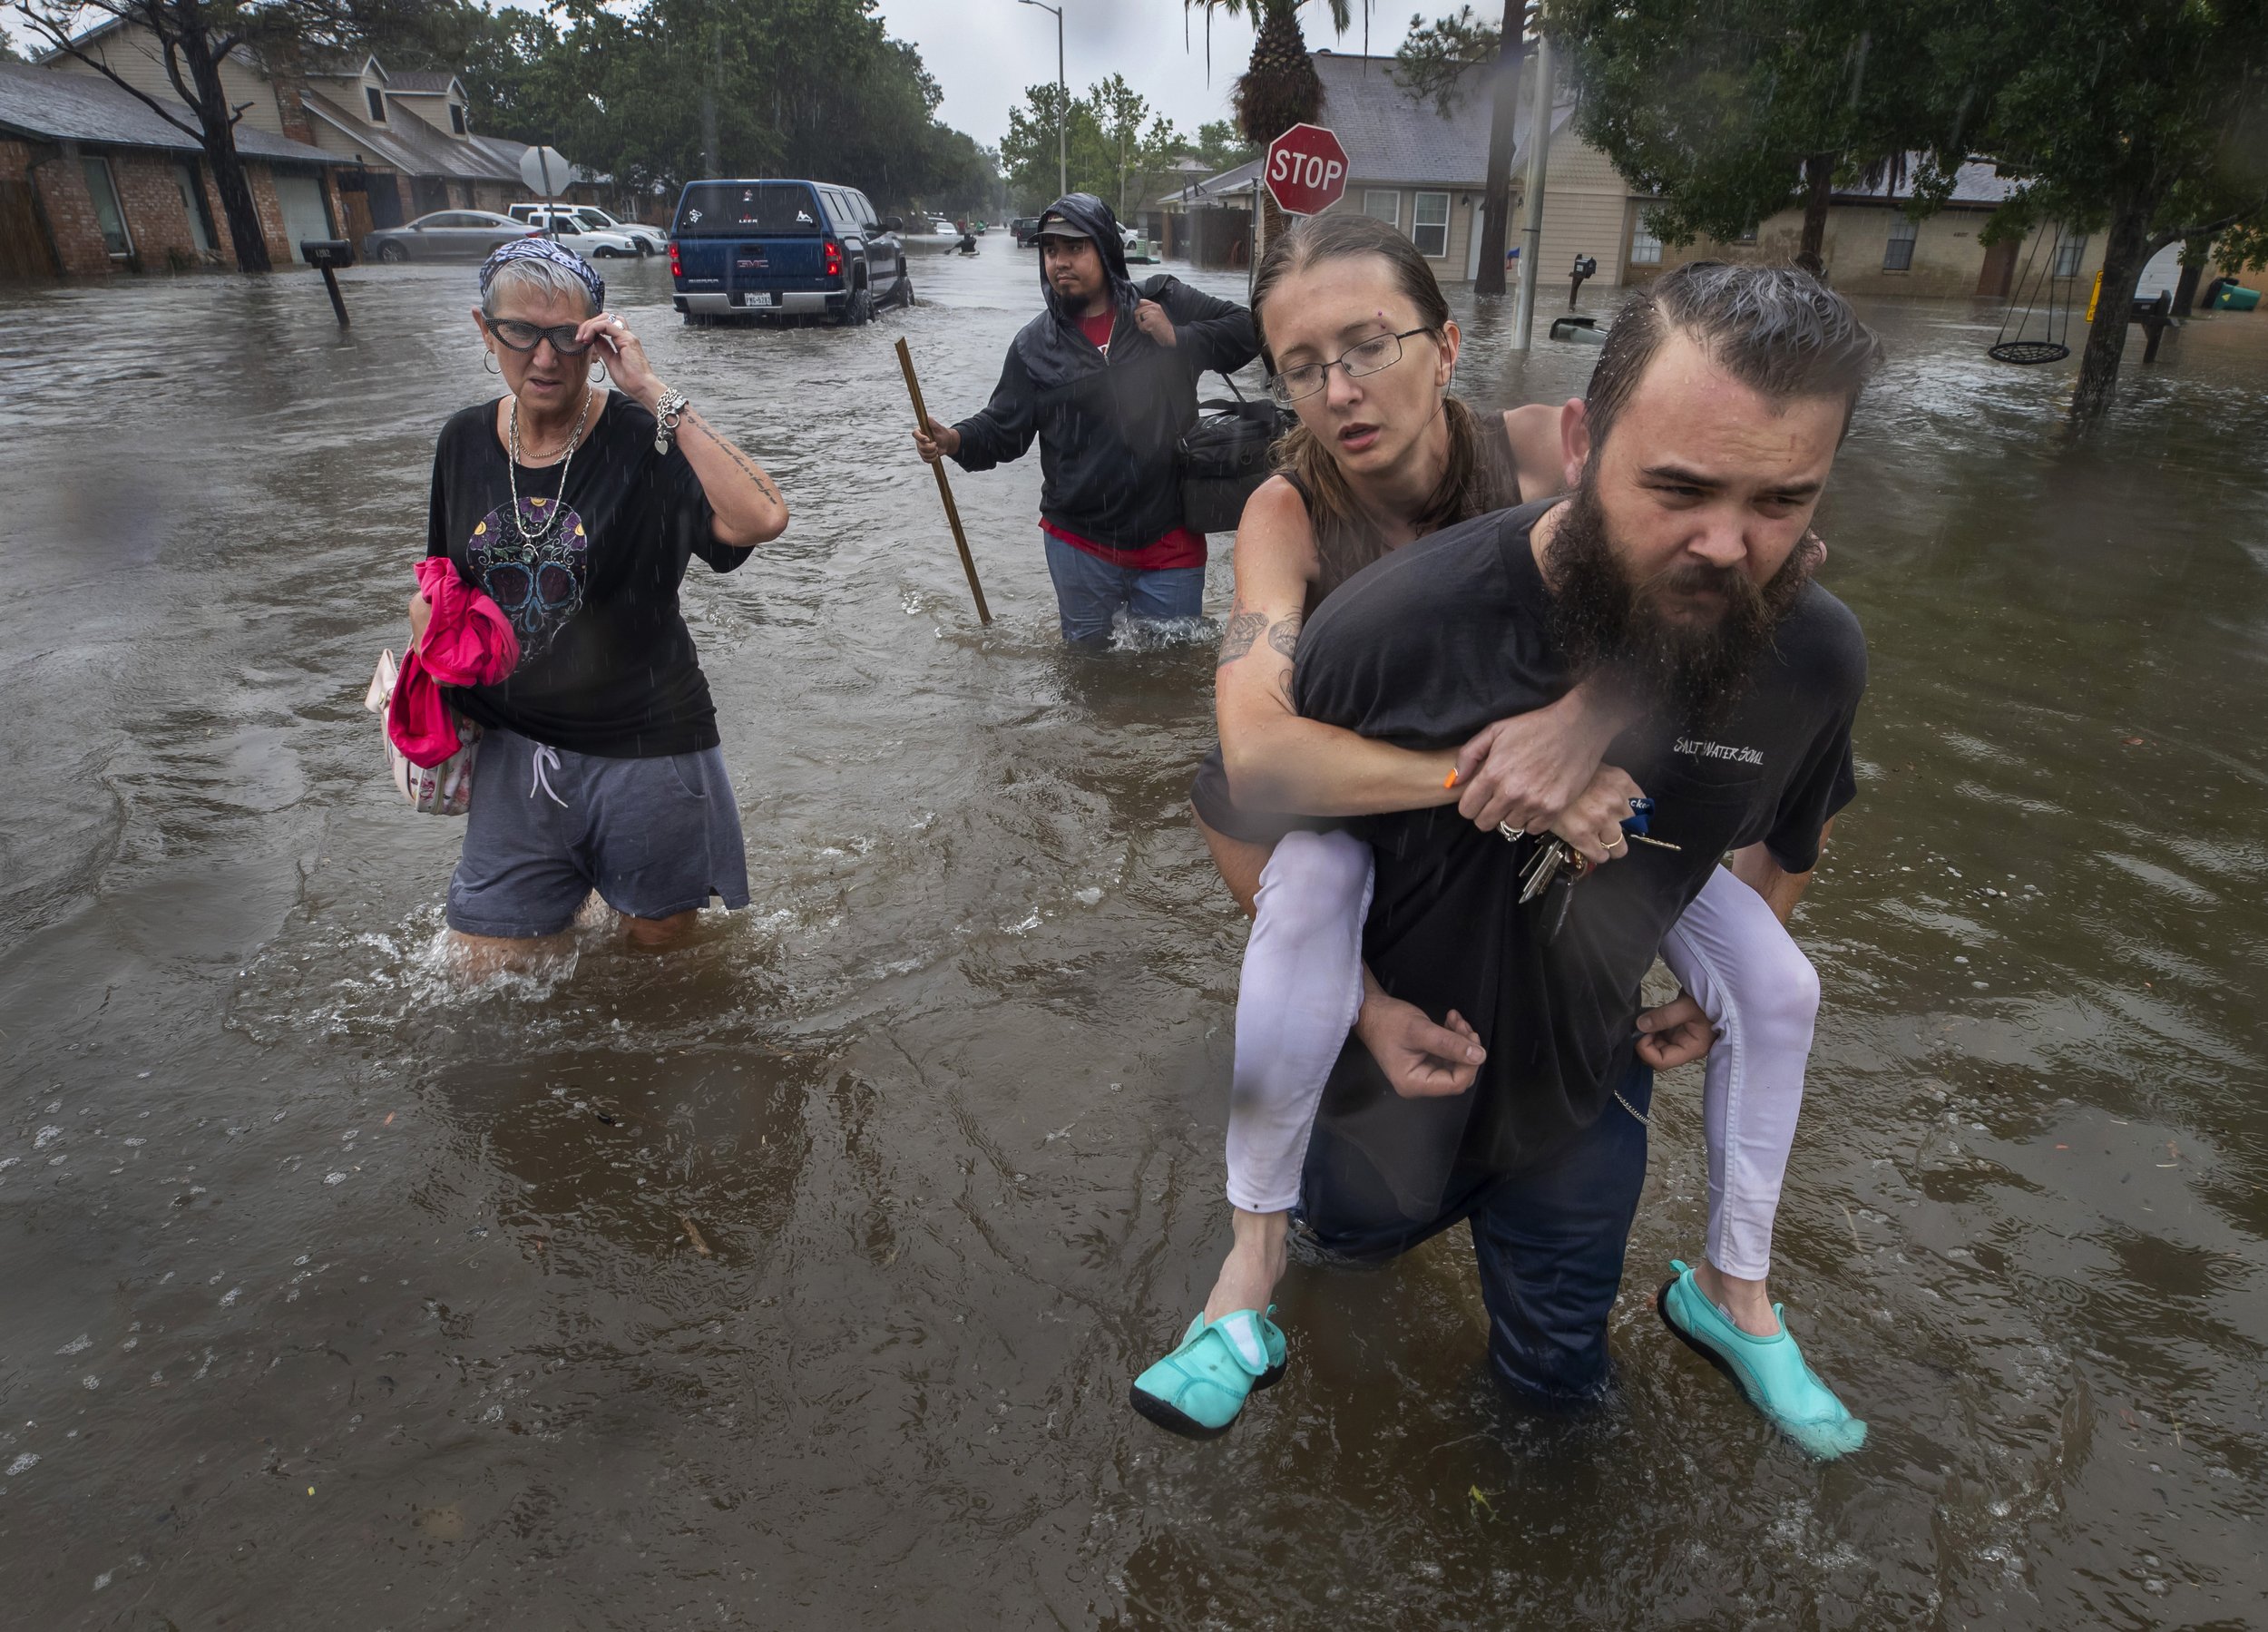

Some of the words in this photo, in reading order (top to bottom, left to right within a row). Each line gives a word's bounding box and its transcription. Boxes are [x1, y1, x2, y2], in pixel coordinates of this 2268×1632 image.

[1271, 149, 1343, 191] STOP
[737, 259, 768, 268] GMC
[1737, 746, 1765, 765] SOUL
